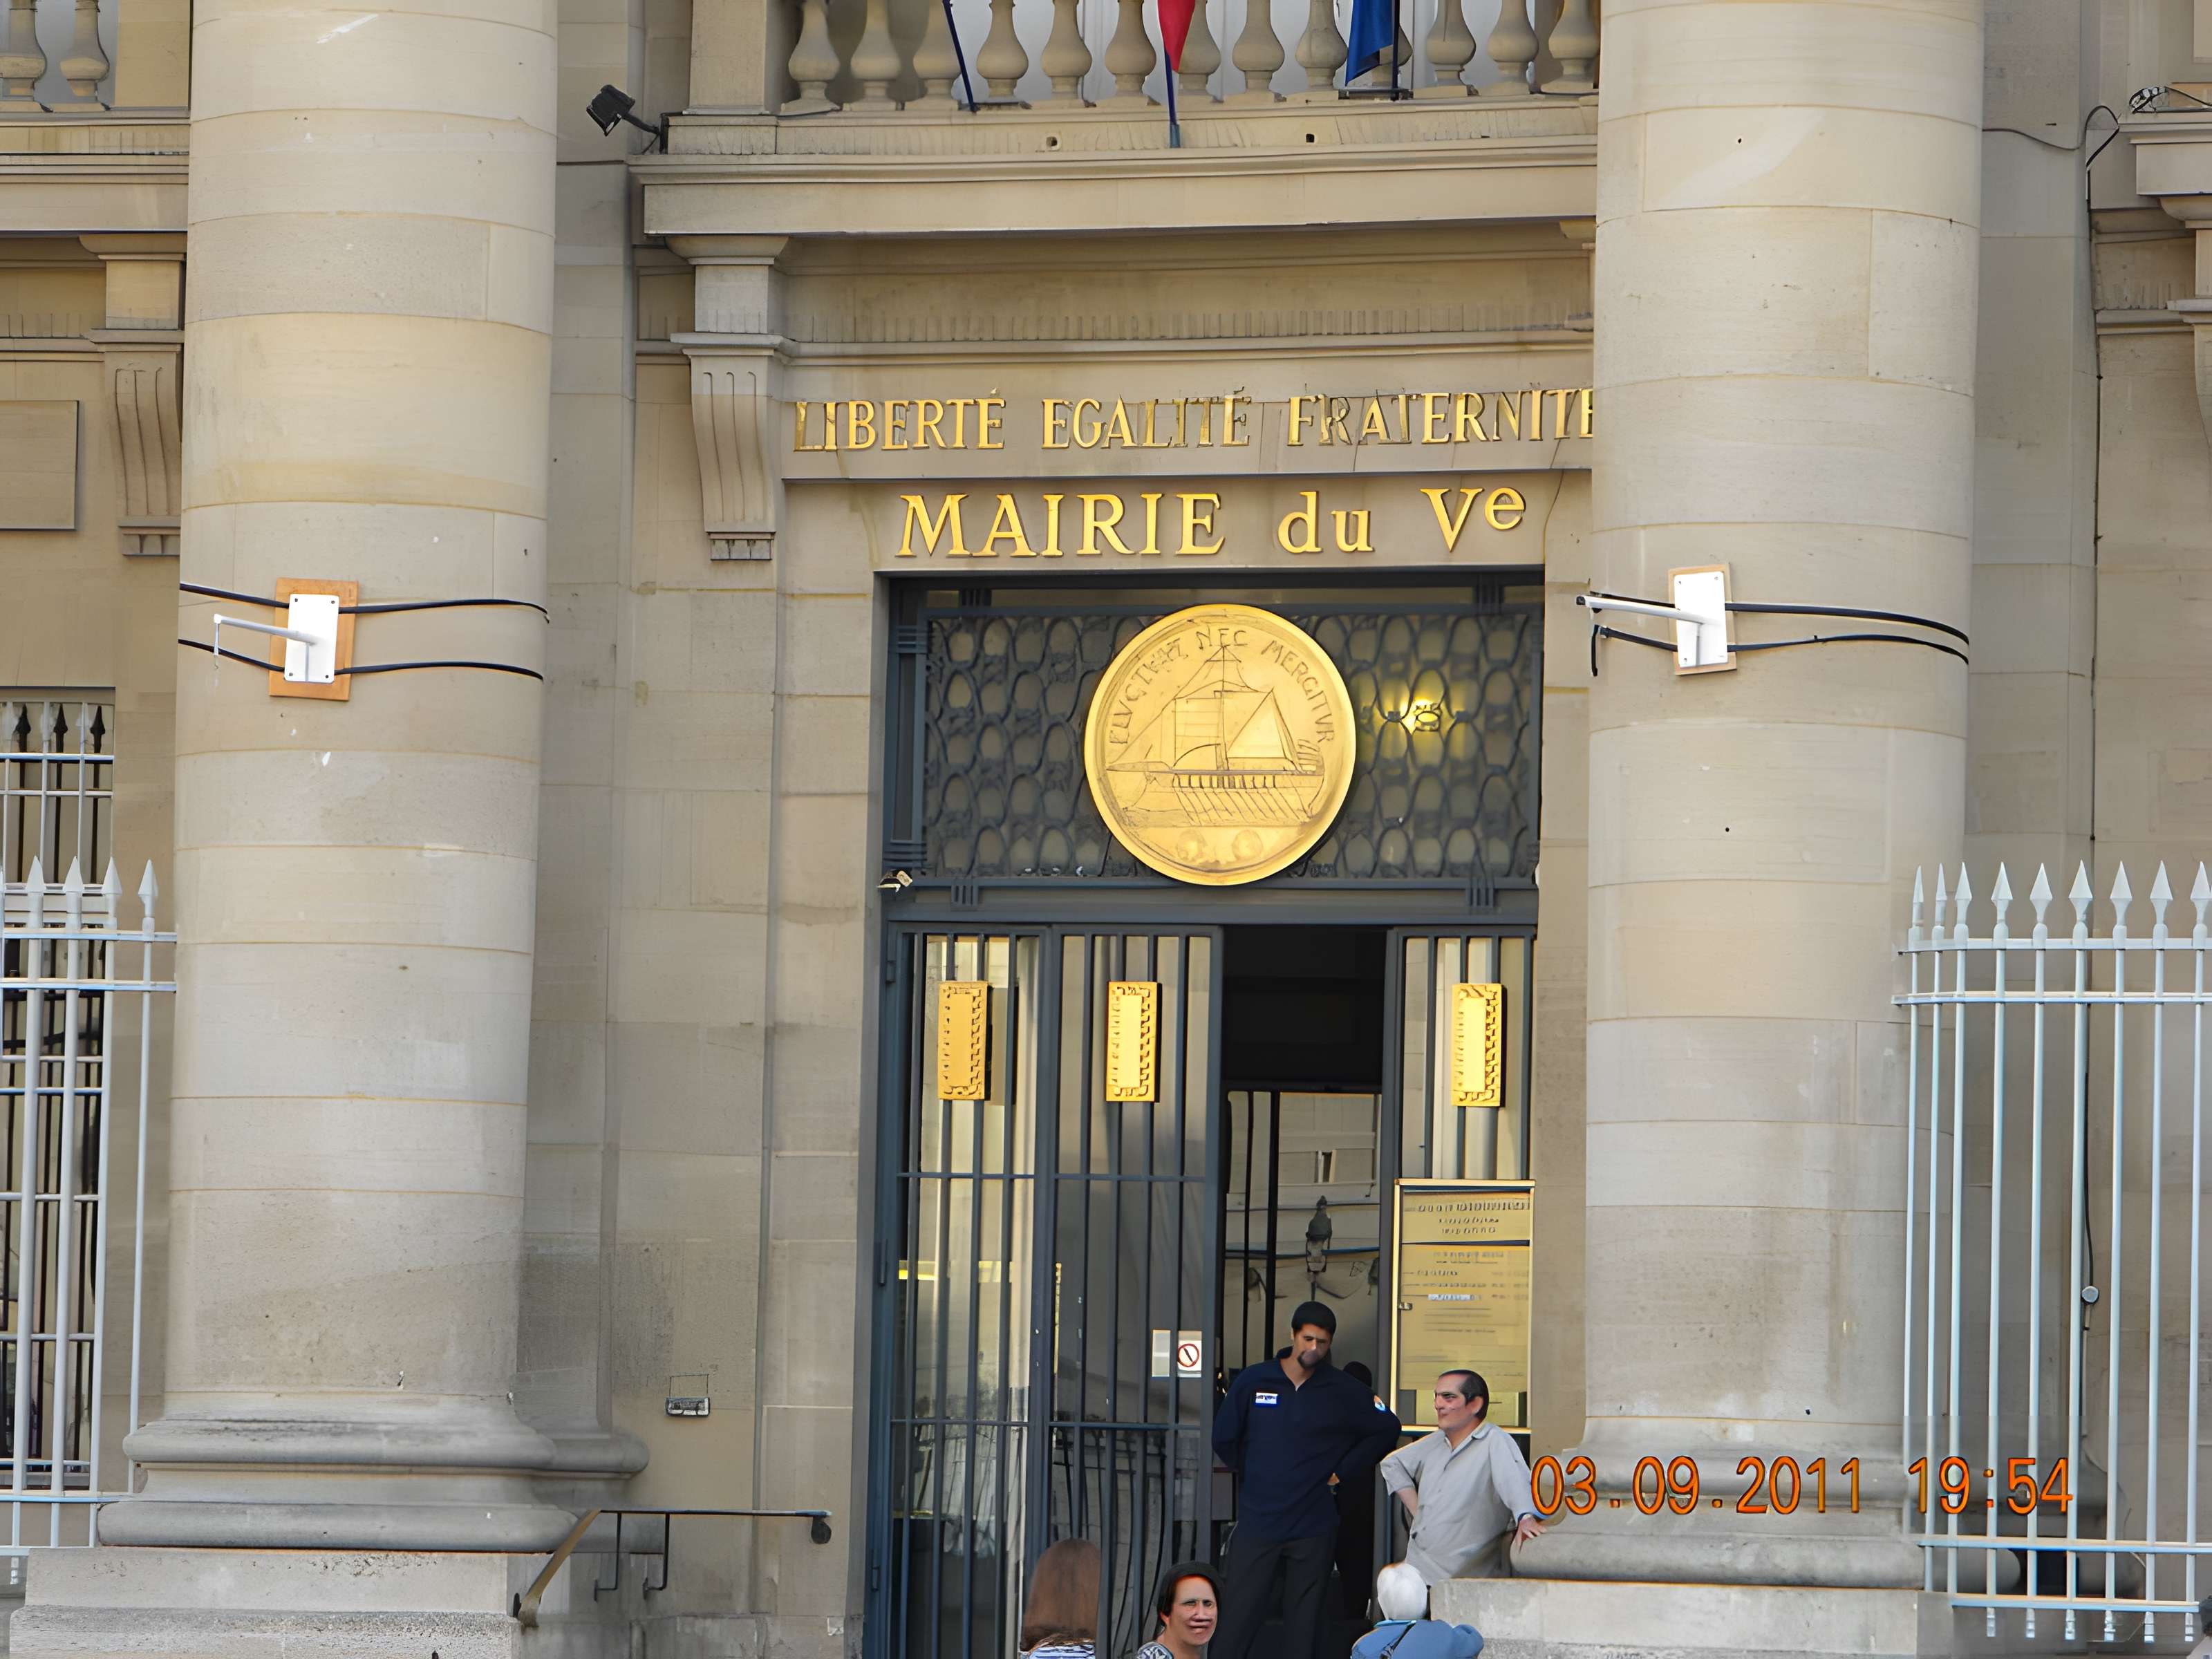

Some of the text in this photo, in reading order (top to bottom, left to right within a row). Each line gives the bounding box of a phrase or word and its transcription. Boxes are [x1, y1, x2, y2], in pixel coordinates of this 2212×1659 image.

[896, 487, 1526, 558] MAIRIE du Ve
